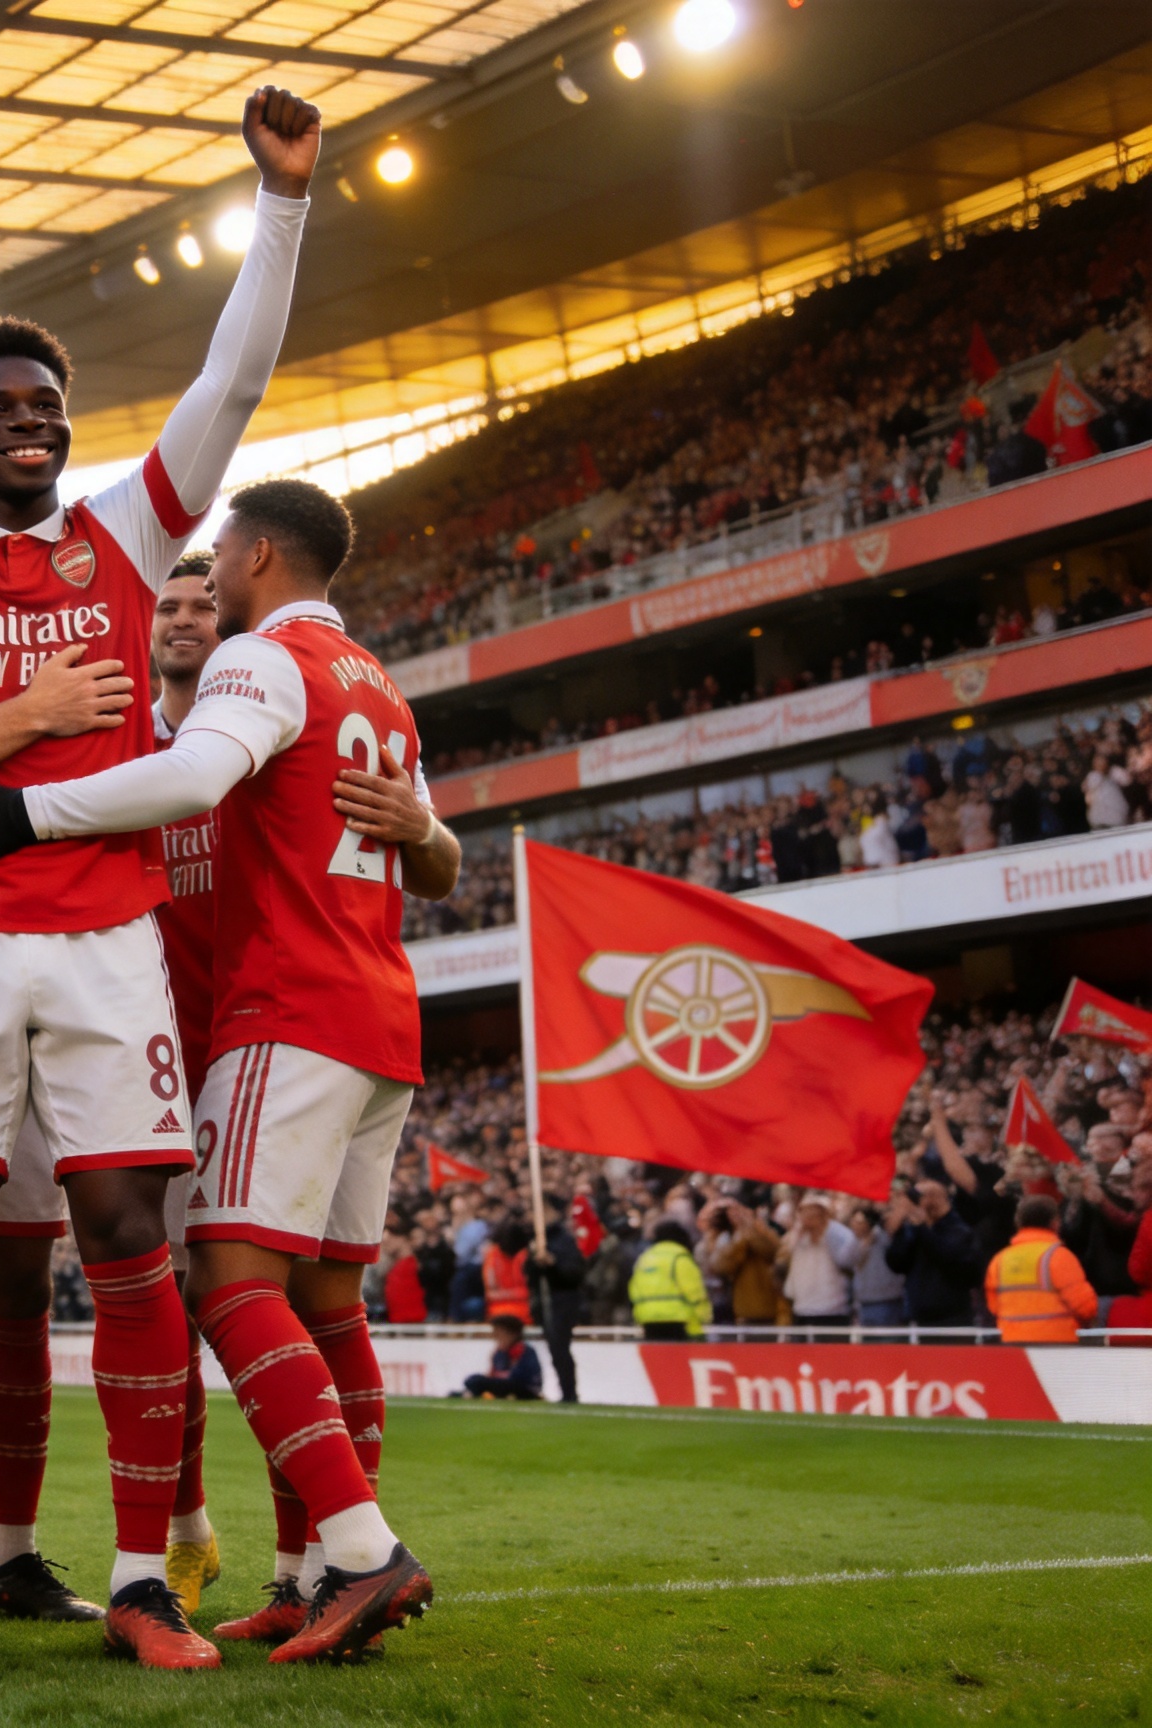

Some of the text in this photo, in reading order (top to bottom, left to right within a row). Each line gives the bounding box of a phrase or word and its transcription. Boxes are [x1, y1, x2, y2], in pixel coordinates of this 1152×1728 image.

[146, 1033, 179, 1101] 8
[196, 1119, 218, 1177] 9
[688, 1358, 988, 1420] Emirates
